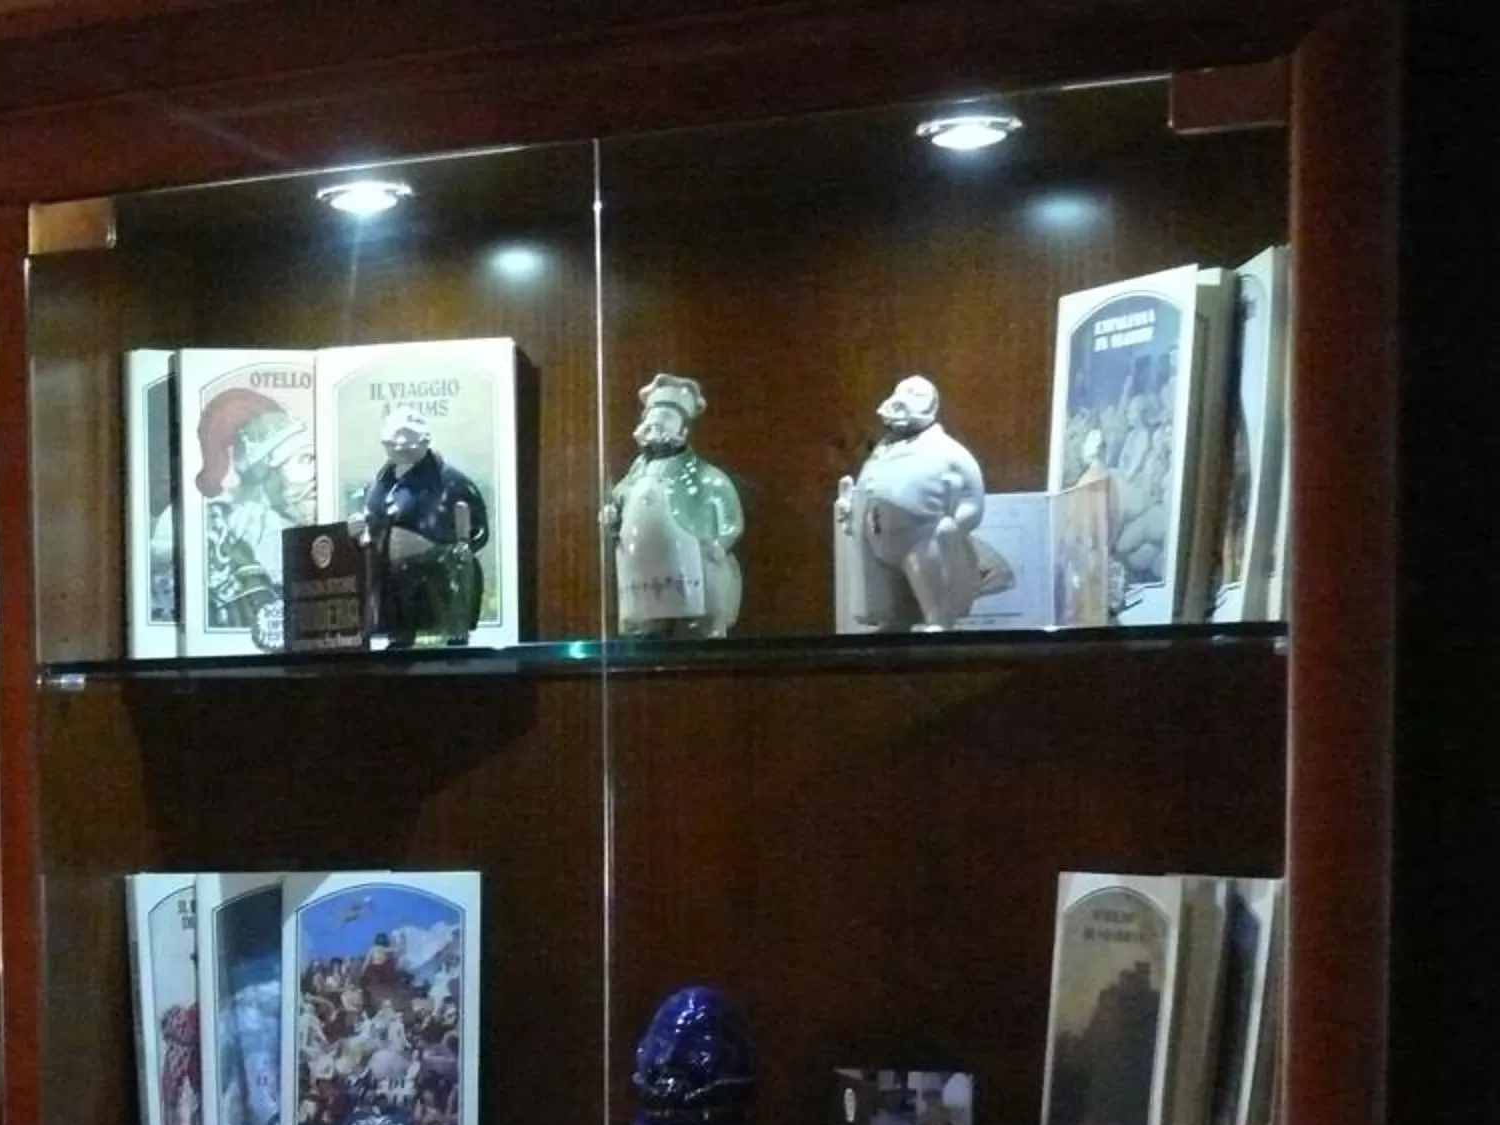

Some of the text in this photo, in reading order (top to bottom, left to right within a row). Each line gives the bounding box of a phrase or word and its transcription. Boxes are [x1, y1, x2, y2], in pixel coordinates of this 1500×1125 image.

[250, 372, 312, 389] OTELLO
[369, 378, 461, 401] IL VIAGGIO
